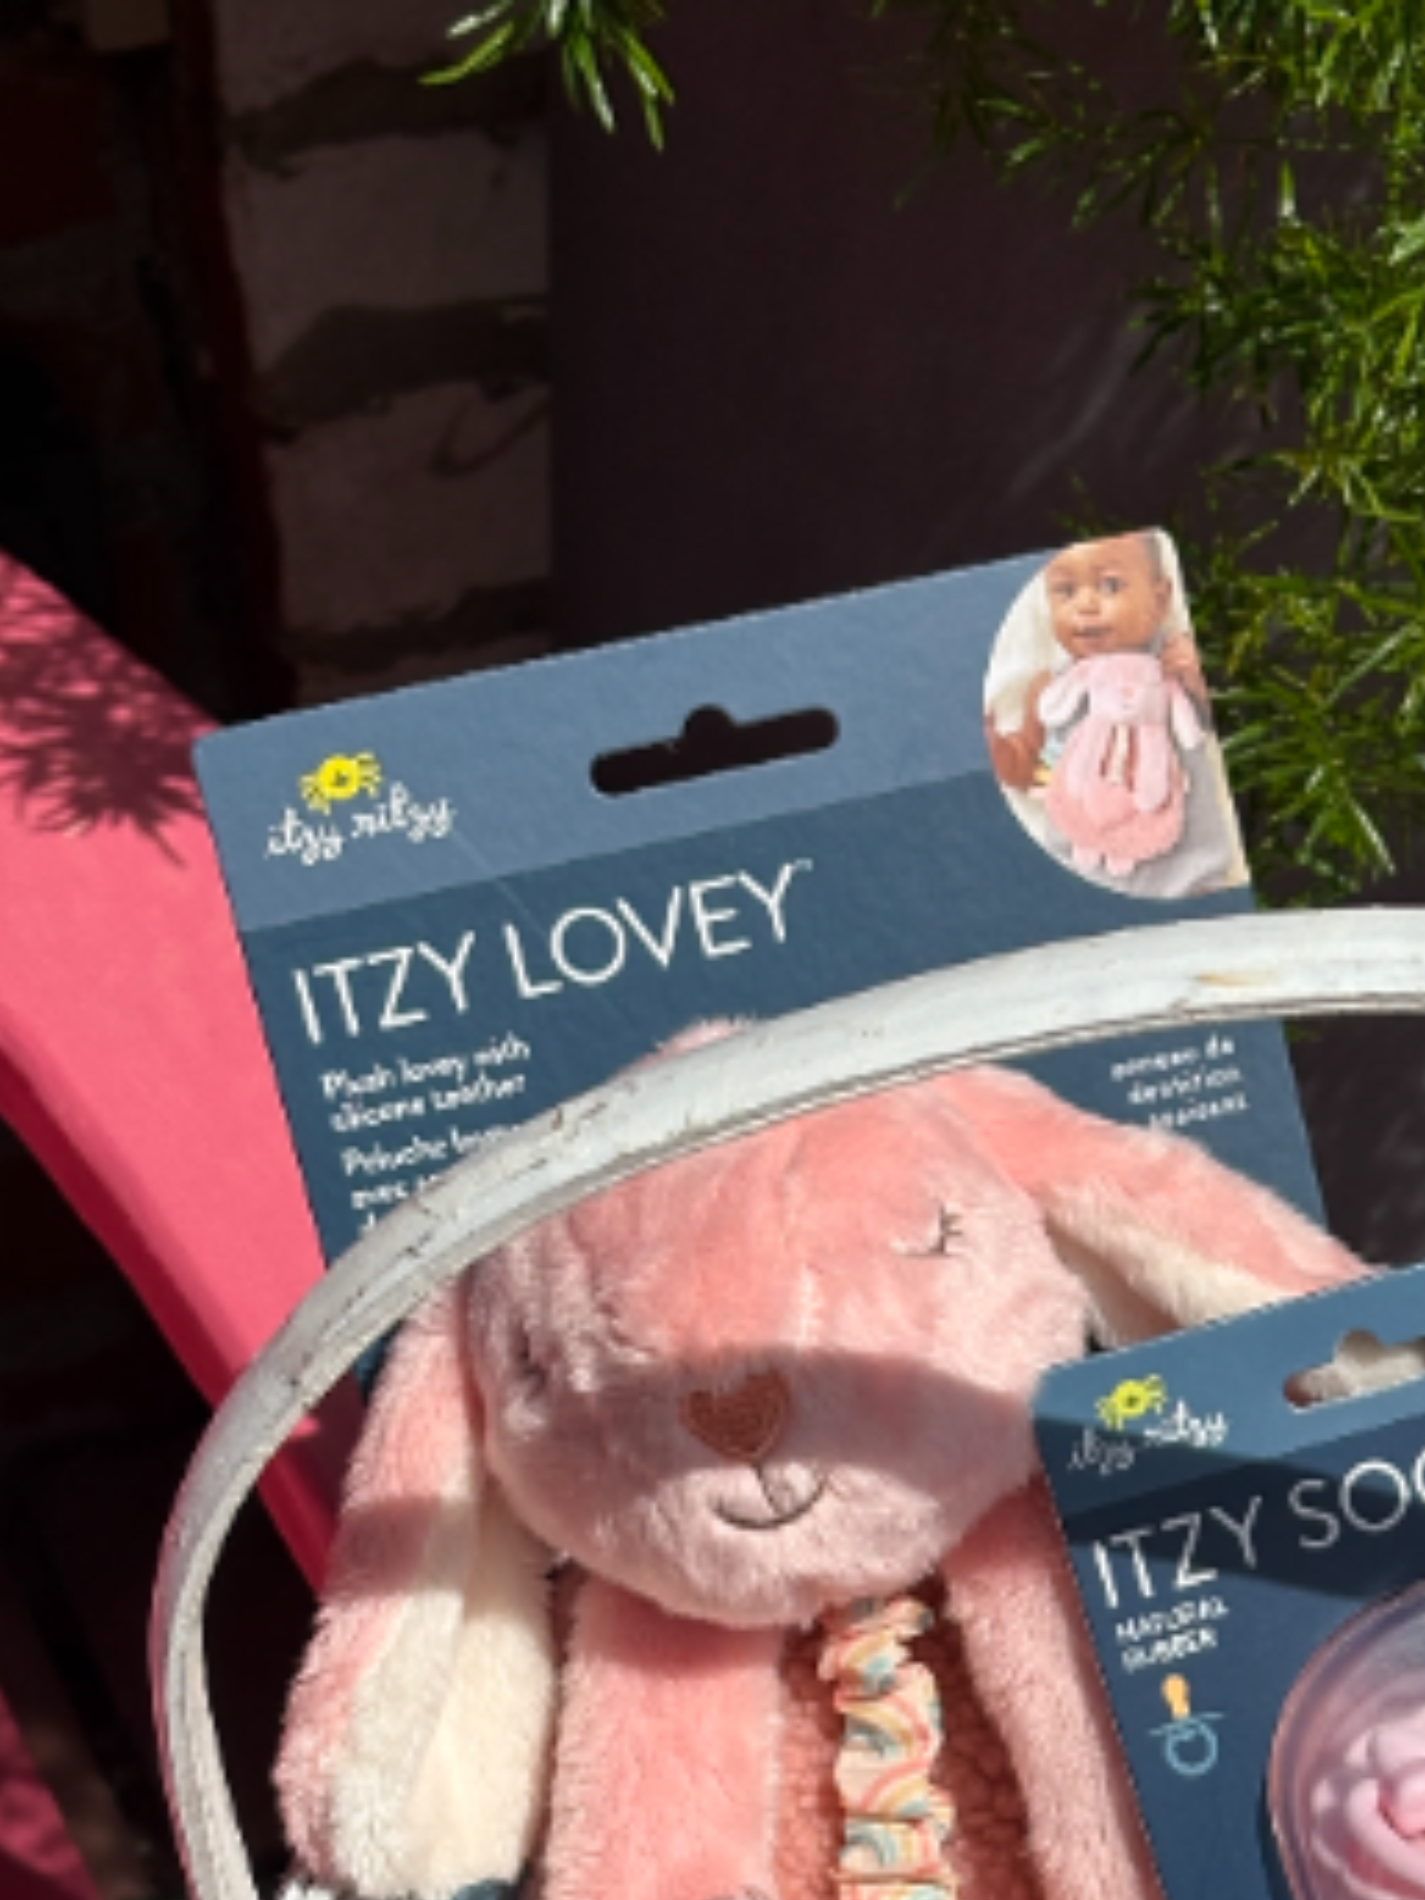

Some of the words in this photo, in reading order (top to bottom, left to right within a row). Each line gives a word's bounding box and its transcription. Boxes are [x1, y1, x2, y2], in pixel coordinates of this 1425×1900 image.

[265, 808, 344, 866] itzy
[294, 930, 476, 1044] ITZY
[505, 862, 794, 999] LOVEY
[320, 1063, 396, 1100] Plush
[397, 1055, 468, 1083] lovey
[474, 1031, 532, 1066] with
[1091, 1496, 1263, 1608] ITZY
[1115, 1595, 1230, 1644] NATURAL
[1121, 1627, 1218, 1674] RUBBER
